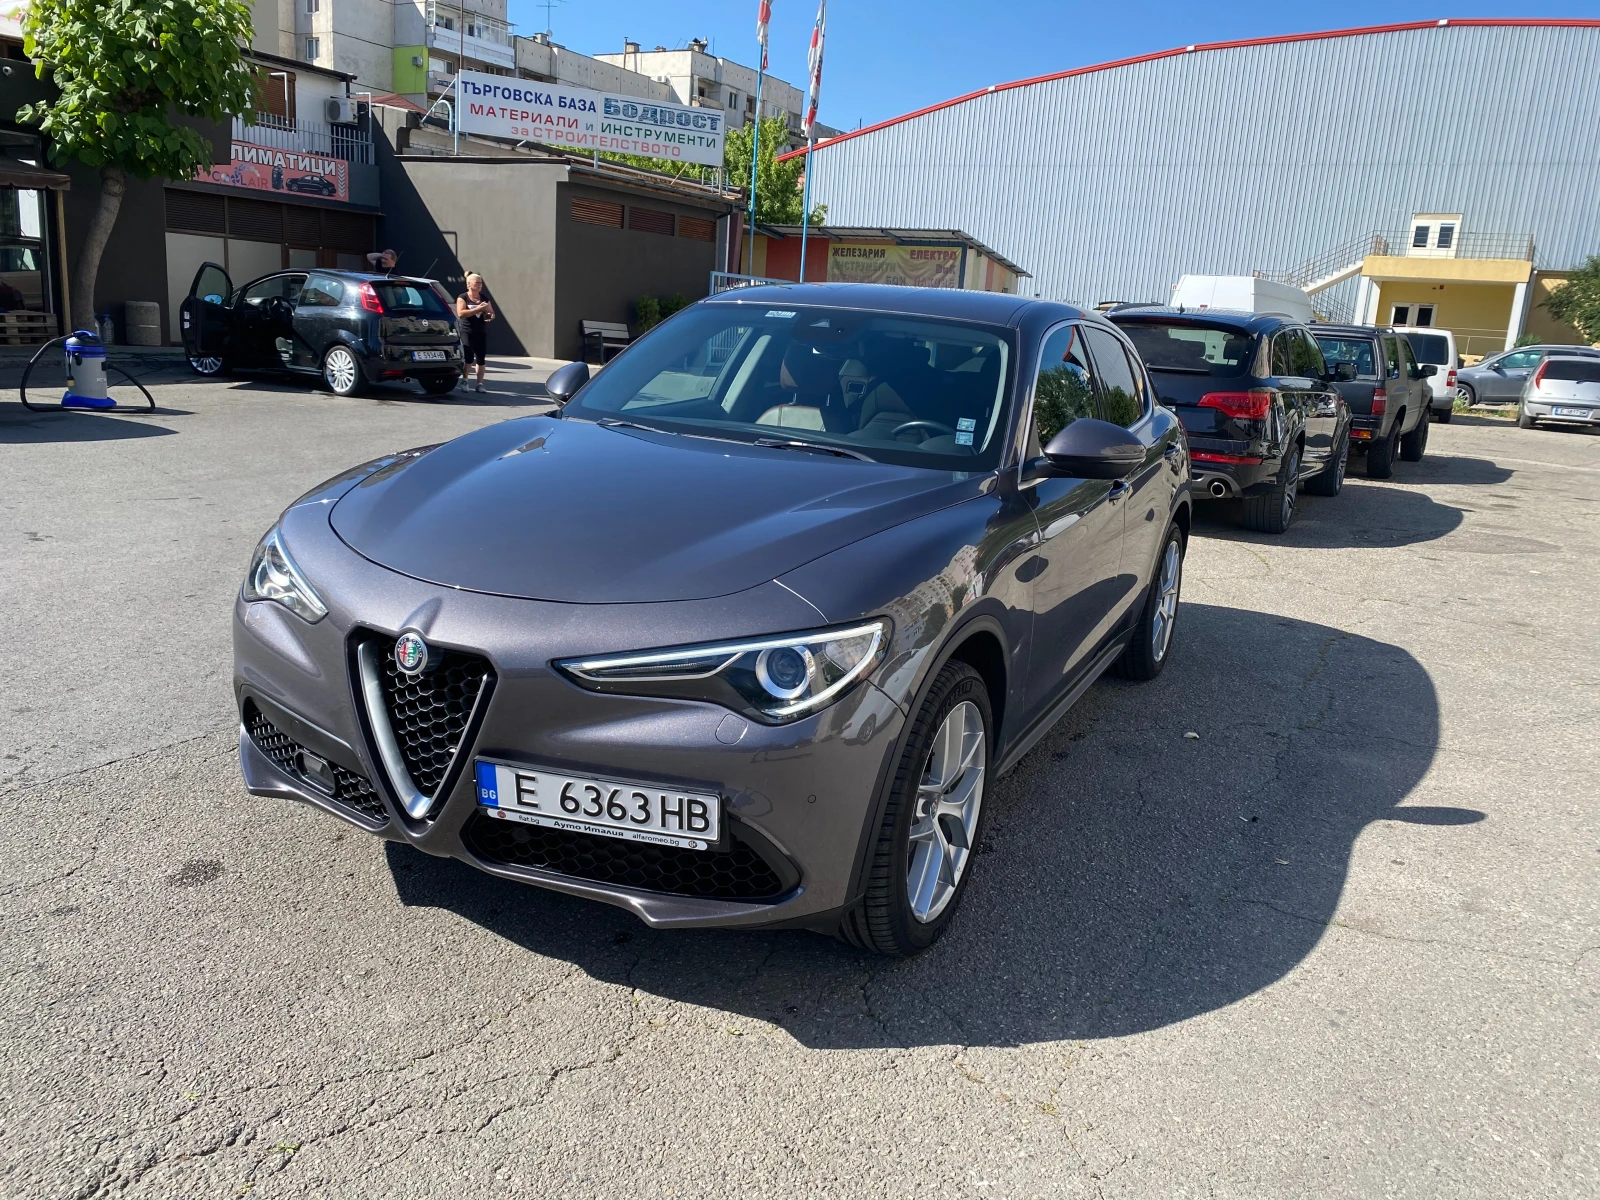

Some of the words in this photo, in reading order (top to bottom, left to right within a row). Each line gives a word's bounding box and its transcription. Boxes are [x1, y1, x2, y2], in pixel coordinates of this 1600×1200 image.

[461, 80, 553, 106] ТЪРГОВСКА
[558, 96, 597, 113] БАЗА
[470, 103, 579, 129] МАТЕРИАЛИ
[601, 122, 716, 148] ИНСТРУМЕНТИ
[511, 126, 529, 135] за
[533, 127, 681, 157] СТРОИТЕЛСТВОТО
[231, 144, 337, 177] ЛИМАТИЦИ
[832, 247, 886, 259] ЖЕЛЕЗАРИЯ
[909, 249, 957, 260] ЕЛЕКТРО
[481, 788, 497, 800] BG
[514, 773, 539, 808] E
[559, 780, 651, 824] 6363
[632, 832, 680, 847] alfaromeo.bg
